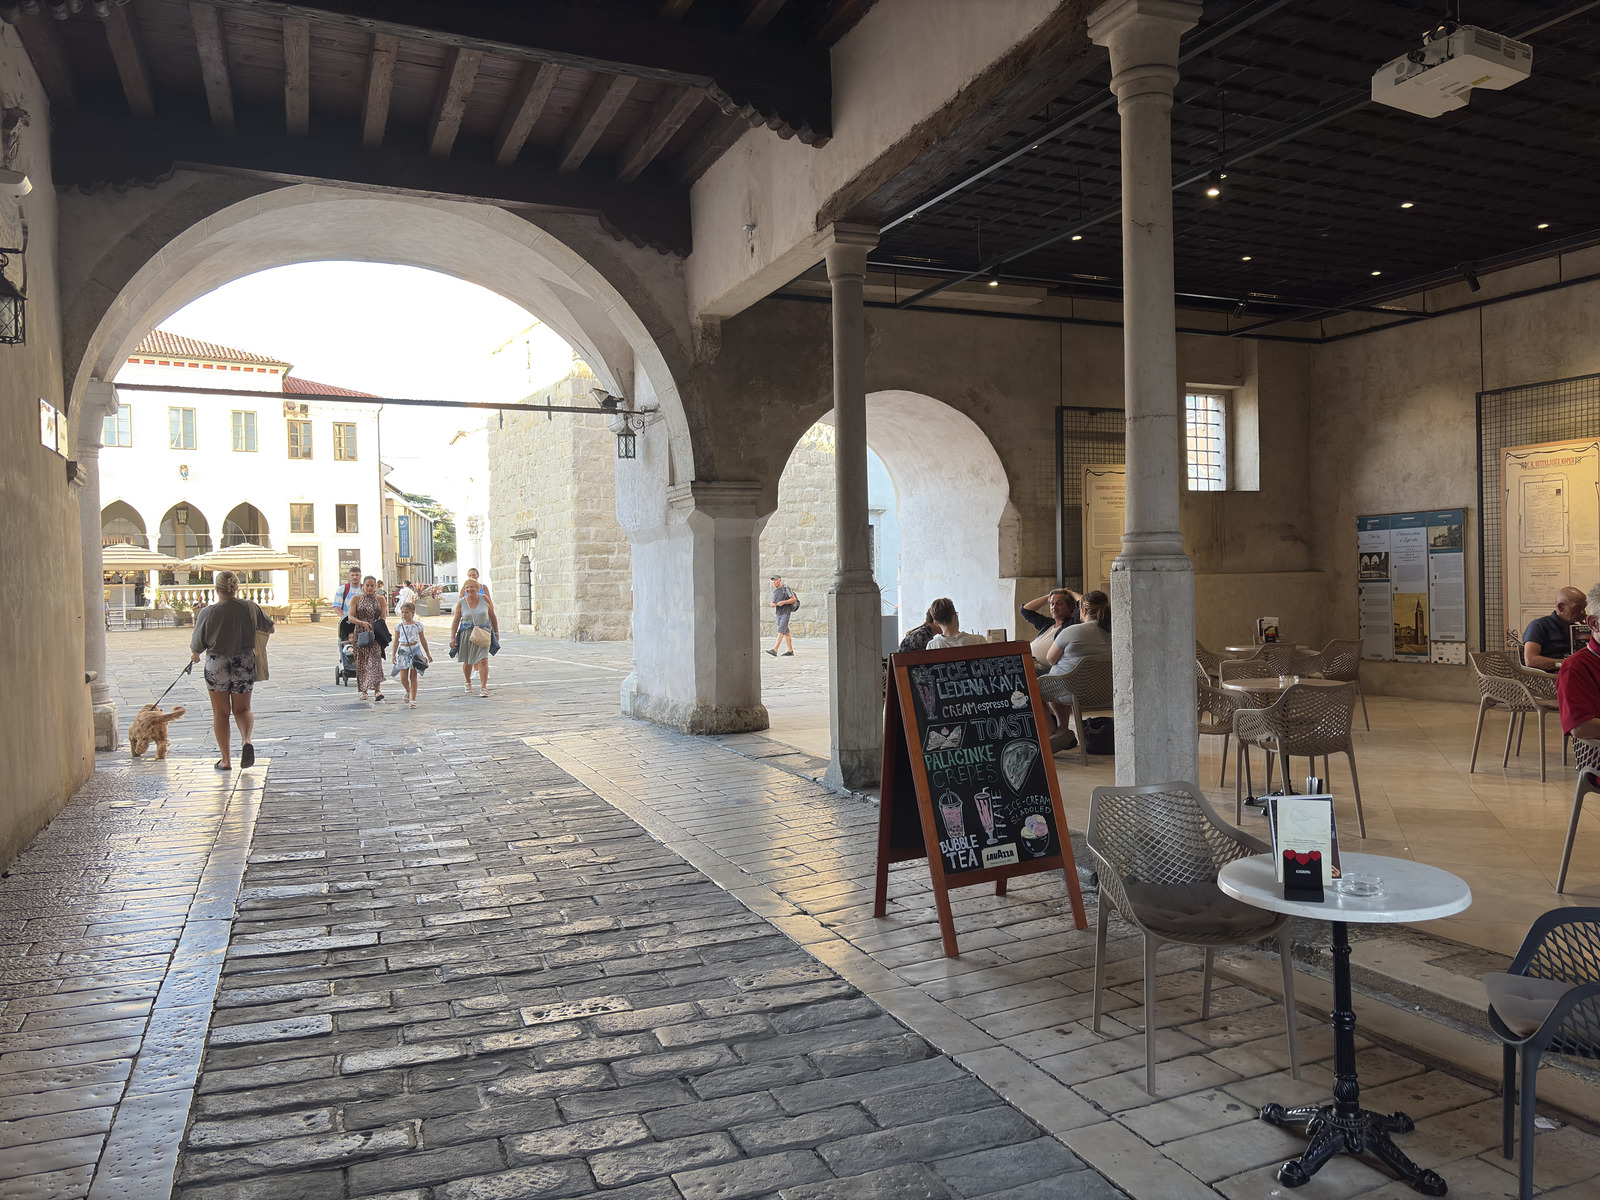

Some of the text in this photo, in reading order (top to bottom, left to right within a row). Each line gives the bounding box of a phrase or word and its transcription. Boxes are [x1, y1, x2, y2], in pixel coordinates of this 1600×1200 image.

[933, 655, 1024, 682] ICE COFFEE
[936, 674, 1025, 700] LEDENA KAVA
[942, 701, 977, 718] CREAM
[970, 712, 1033, 741] TOAST
[924, 744, 997, 771] PALACINKE
[933, 764, 999, 788] CREPES
[991, 789, 1008, 838] FRAPE
[1011, 806, 1052, 824] SLADOLED
[939, 834, 979, 854] BUBBLE
[986, 849, 1015, 861] LAVAZZA
[946, 848, 979, 870] TEA
